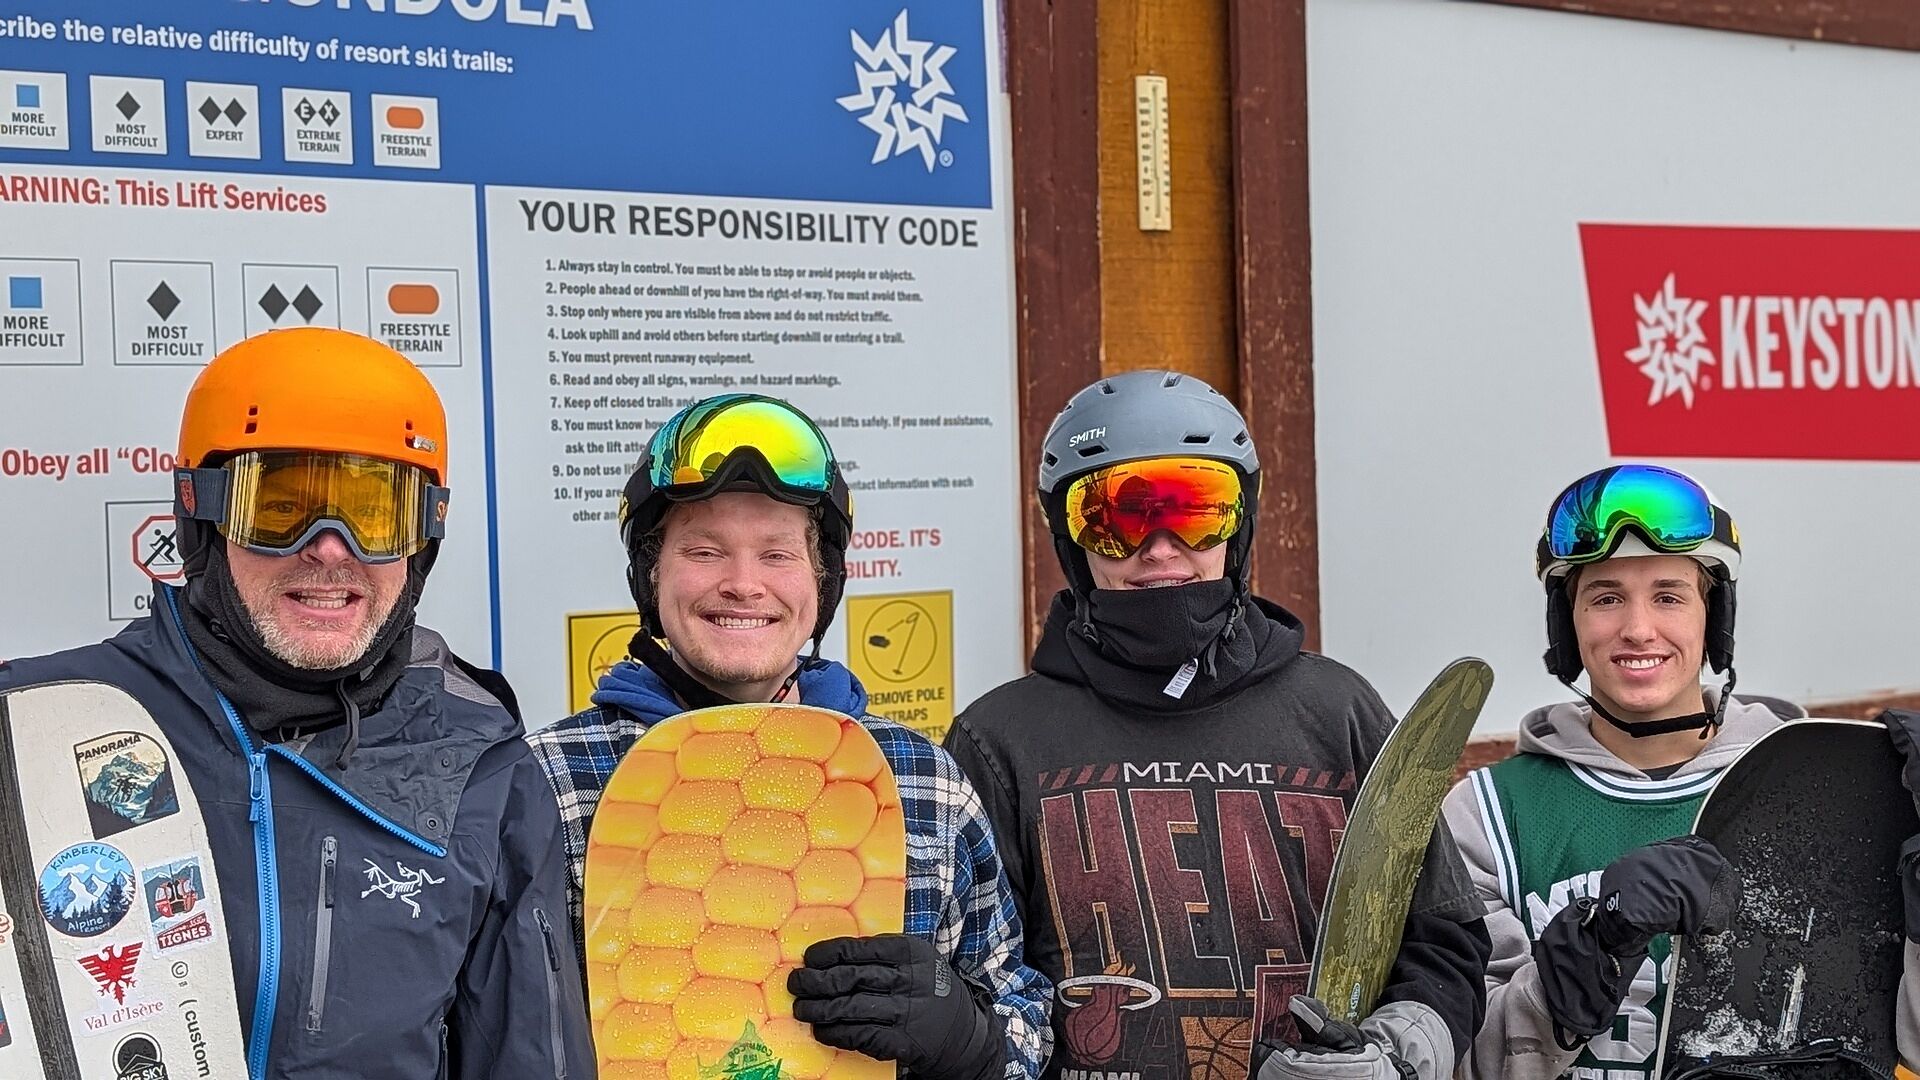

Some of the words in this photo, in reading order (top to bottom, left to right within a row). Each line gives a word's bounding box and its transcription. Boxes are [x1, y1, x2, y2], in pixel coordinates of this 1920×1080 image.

[63, 19, 105, 43] the
[112, 24, 202, 50] relative
[209, 30, 310, 62] difficulty
[316, 38, 339, 61] of
[345, 45, 410, 66] resort
[415, 47, 447, 68] ski
[452, 50, 514, 74] trails:
[12, 113, 45, 124] MORE
[1, 125, 56, 137] DIFFICULT
[116, 124, 146, 135] MOST
[206, 130, 243, 142] EXPERT
[297, 129, 341, 142] EXTREME
[105, 135, 158, 148] DIFFICULT
[298, 141, 340, 153] TERRAIN
[381, 134, 433, 147] FREESTYLE
[386, 146, 427, 158] TERRAIN
[116, 180, 170, 207] This
[176, 182, 218, 209] Lift
[224, 184, 327, 213] Services
[519, 199, 617, 235] YOUR
[629, 203, 891, 245] RESPONSIBILITY
[899, 217, 979, 248] CODE
[546, 260, 556, 271] 1.
[558, 260, 595, 274] Always
[598, 261, 618, 275] stay
[621, 261, 631, 273] in
[634, 262, 673, 274] control.
[675, 263, 694, 275] You
[697, 265, 722, 276] must
[724, 264, 736, 276] be
[738, 266, 759, 277] able
[762, 266, 771, 277] to
[774, 267, 795, 280] stop
[796, 268, 806, 278] or
[808, 267, 833, 279] avoid
[835, 268, 866, 281] people
[868, 270, 877, 280] or
[879, 269, 915, 282] objects.
[546, 282, 557, 294] 2.
[560, 283, 596, 297] People
[599, 284, 631, 295] ahead
[634, 286, 644, 295] or
[647, 284, 689, 296] downhill
[692, 285, 702, 297] of
[704, 288, 721, 299] you
[723, 287, 746, 298] have
[748, 288, 764, 299] the
[766, 288, 825, 301] right-of-way.
[827, 289, 844, 300] You
[847, 290, 869, 301] must
[872, 290, 895, 301] avoid
[897, 290, 923, 302] them.
[546, 305, 558, 317] 3.
[560, 305, 585, 319] Stop
[587, 306, 609, 320] only
[611, 306, 642, 318] where
[645, 309, 663, 320] you
[665, 309, 682, 319] are
[684, 308, 716, 319] visible
[718, 308, 741, 320] from
[743, 310, 771, 321] above
[774, 310, 791, 321] and
[794, 310, 806, 321] do
[808, 311, 823, 321] not
[825, 310, 859, 322] restrict
[861, 311, 892, 322] traffic.
[4, 316, 49, 330] MORE
[380, 323, 451, 336] FREESTYLE
[147, 326, 188, 339] MOST
[547, 329, 558, 340] 4.
[561, 329, 587, 341] Look
[589, 329, 619, 342] uphill
[622, 329, 641, 341] and
[644, 330, 670, 341] avoid
[673, 330, 705, 342] others
[707, 330, 739, 342] before
[741, 331, 780, 344] starting
[782, 331, 821, 343] downhill
[823, 333, 833, 343] or
[835, 332, 873, 346] entering
[883, 332, 905, 343] trail.
[131, 342, 204, 356] DIFFICULT
[388, 339, 443, 352] TERRAIN
[549, 351, 559, 363] 5.
[562, 351, 581, 363] You
[584, 352, 610, 363] must
[613, 352, 652, 365] prevent
[654, 354, 697, 365] runaway
[699, 353, 754, 365] equipment.
[549, 374, 560, 386] 6.
[563, 374, 590, 386] Read
[593, 374, 613, 386] and
[615, 374, 640, 388] obey
[642, 374, 655, 386] all
[657, 374, 688, 388] signs,
[690, 375, 737, 388] warnings,
[740, 375, 758, 386] and
[760, 374, 793, 386] hazard
[795, 374, 841, 388] markings.
[550, 397, 561, 408] 7.
[564, 397, 591, 410] Keep
[593, 396, 608, 408] off
[610, 396, 644, 408] closed
[647, 396, 673, 408] trails
[551, 419, 562, 431] 8.
[564, 419, 584, 431] You
[587, 420, 613, 431] must
[616, 419, 642, 430] know
[841, 416, 859, 427] lifts
[861, 416, 891, 429] safely.
[893, 416, 900, 426] If
[902, 417, 917, 429] you
[919, 416, 940, 426] need
[943, 415, 993, 427] assistance,
[1069, 426, 1107, 448] SMITH
[565, 442, 585, 454] ask
[587, 442, 604, 453] the
[607, 442, 622, 453] lift
[2, 448, 70, 481] Obey
[76, 448, 109, 474] all
[552, 465, 564, 477] 9.
[566, 465, 581, 476] Do
[583, 465, 601, 476] not
[603, 466, 620, 475] use
[878, 477, 929, 489] information
[931, 477, 950, 488] with
[952, 477, 974, 488] each
[554, 488, 572, 499] 10.
[574, 487, 583, 498] If
[585, 489, 603, 501] you
[572, 510, 602, 522] other
[851, 530, 905, 549] CODE.
[910, 528, 941, 547] IT'S
[867, 690, 914, 706] REMOVE
[917, 687, 945, 702] POLE
[77, 734, 142, 761] PANORAMA
[1123, 762, 1275, 785] MIAMI
[50, 845, 124, 870] KIMBERLEY
[1038, 787, 1348, 998] HEAT
[68, 916, 104, 933] Alpine
[159, 926, 208, 948] TIGNES
[84, 1014, 109, 1032] Val
[142, 1065, 165, 1080] SKY
